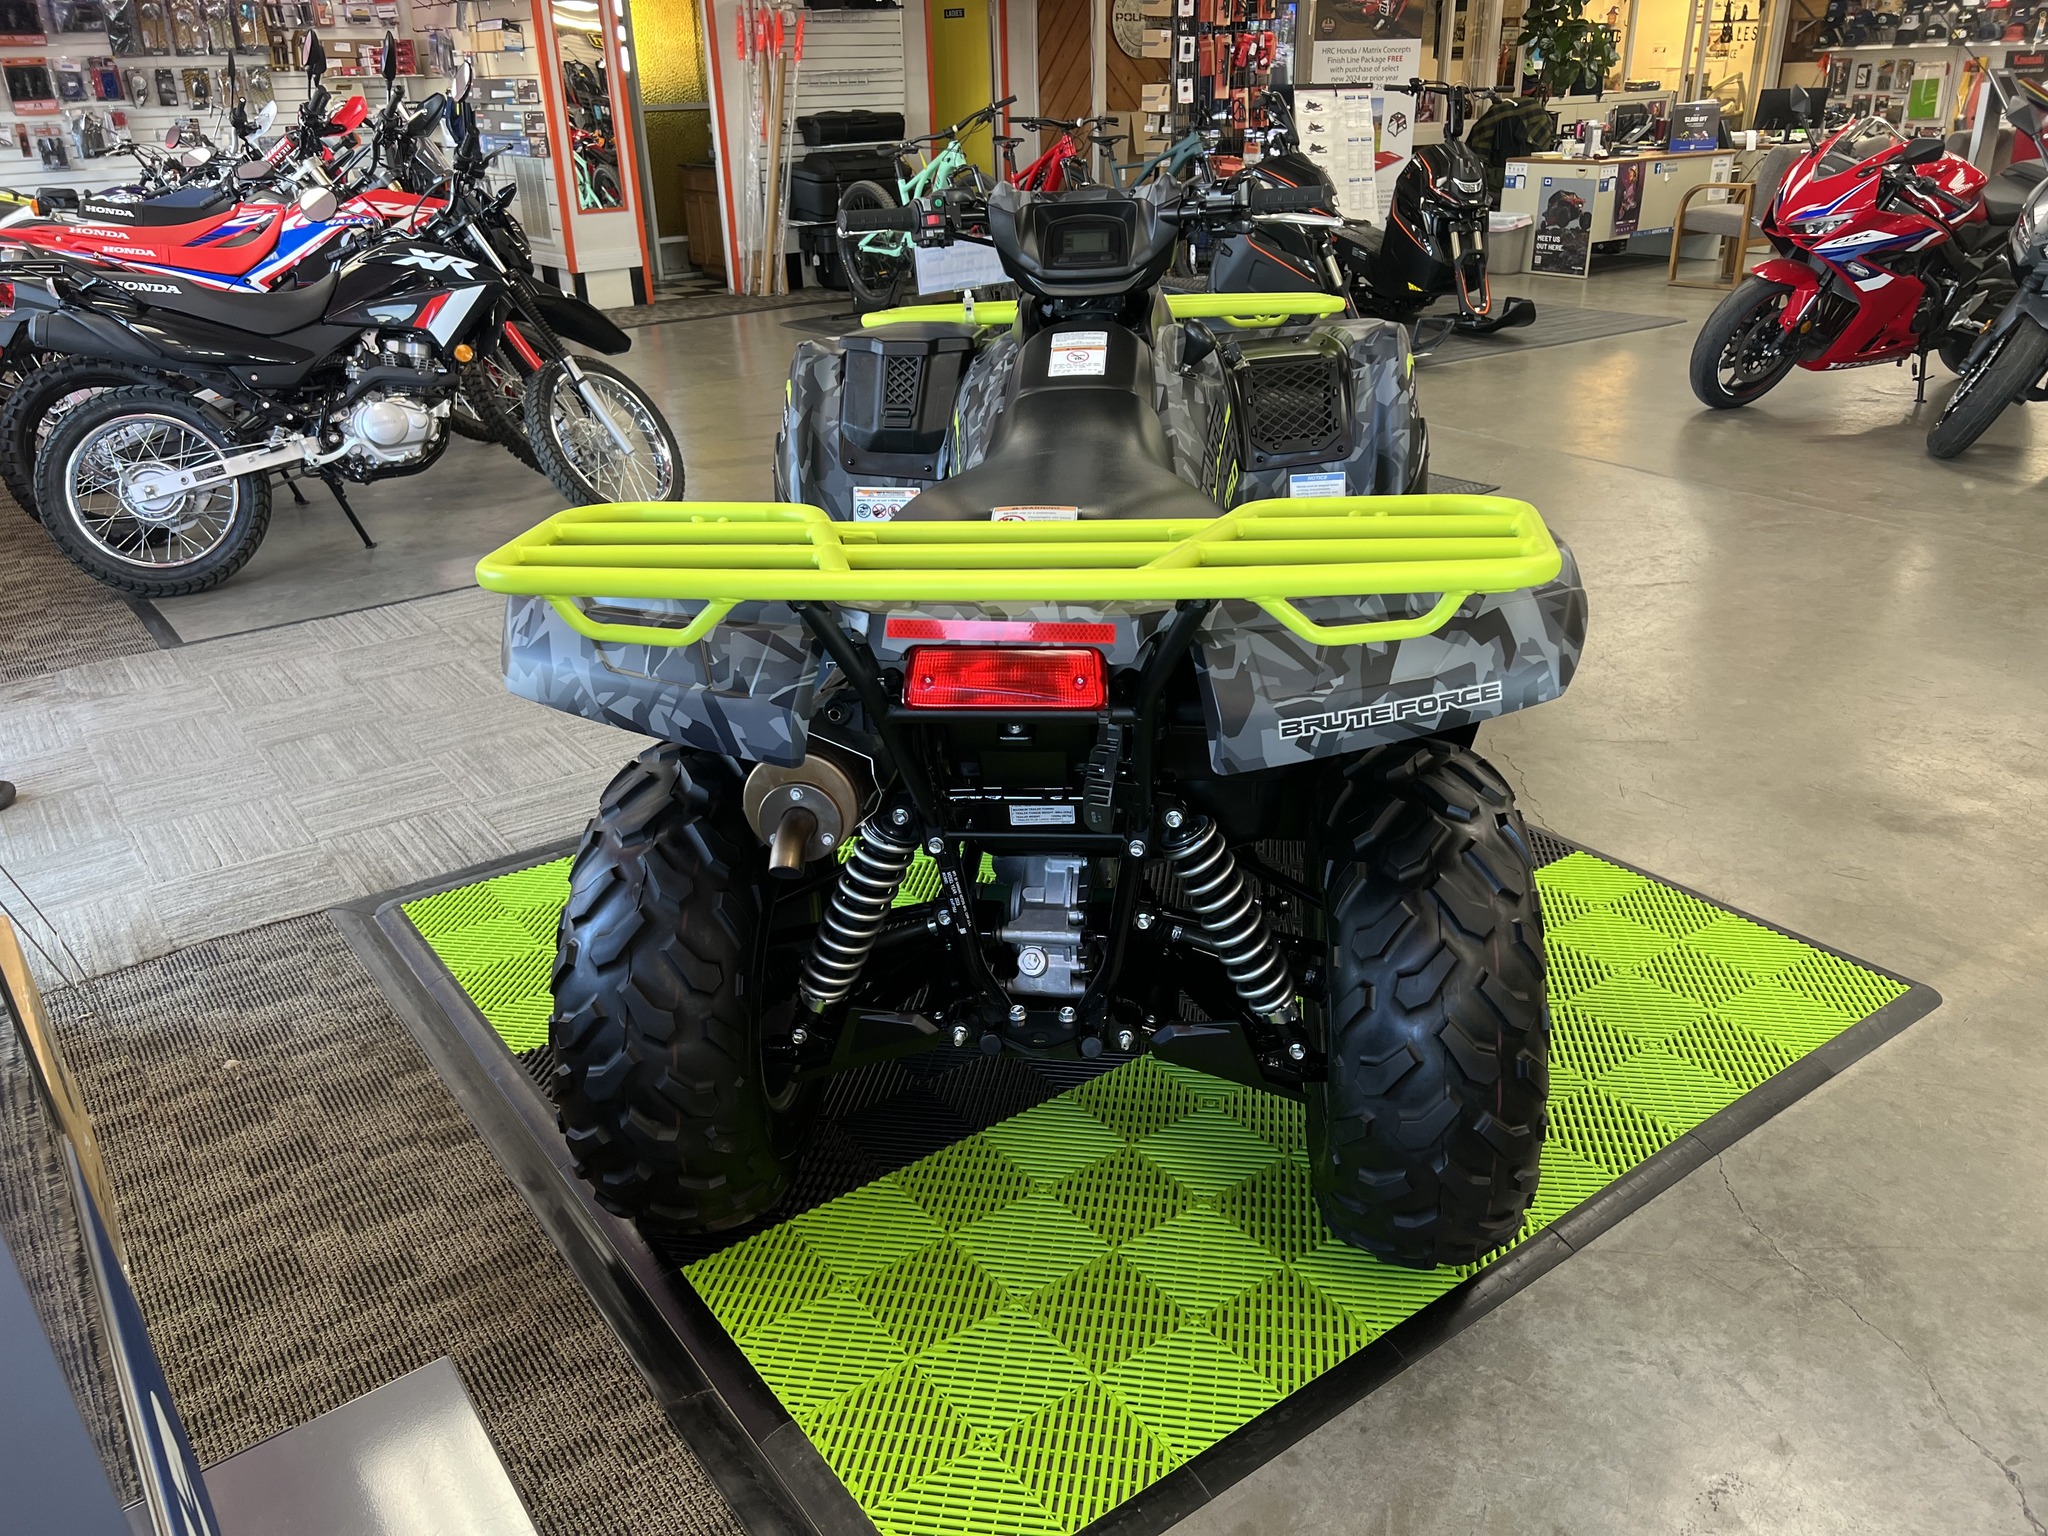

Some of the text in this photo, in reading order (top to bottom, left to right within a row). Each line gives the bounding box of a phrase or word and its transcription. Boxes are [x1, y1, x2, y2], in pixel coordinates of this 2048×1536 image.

[1362, 46, 1381, 54] Matrix
[1383, 46, 1412, 54] Concepts
[1327, 56, 1346, 64] Finish
[1361, 56, 1387, 65] Package
[1345, 65, 1373, 74] purchase
[1369, 75, 1385, 83] prior
[85, 204, 135, 218] HONDA
[325, 217, 373, 226] RALLY
[69, 226, 130, 240] HONDA
[1553, 235, 1560, 243] US
[102, 245, 157, 257] HONDA
[391, 248, 480, 281] XR
[1278, 680, 1503, 741] BRUTE FORCE
